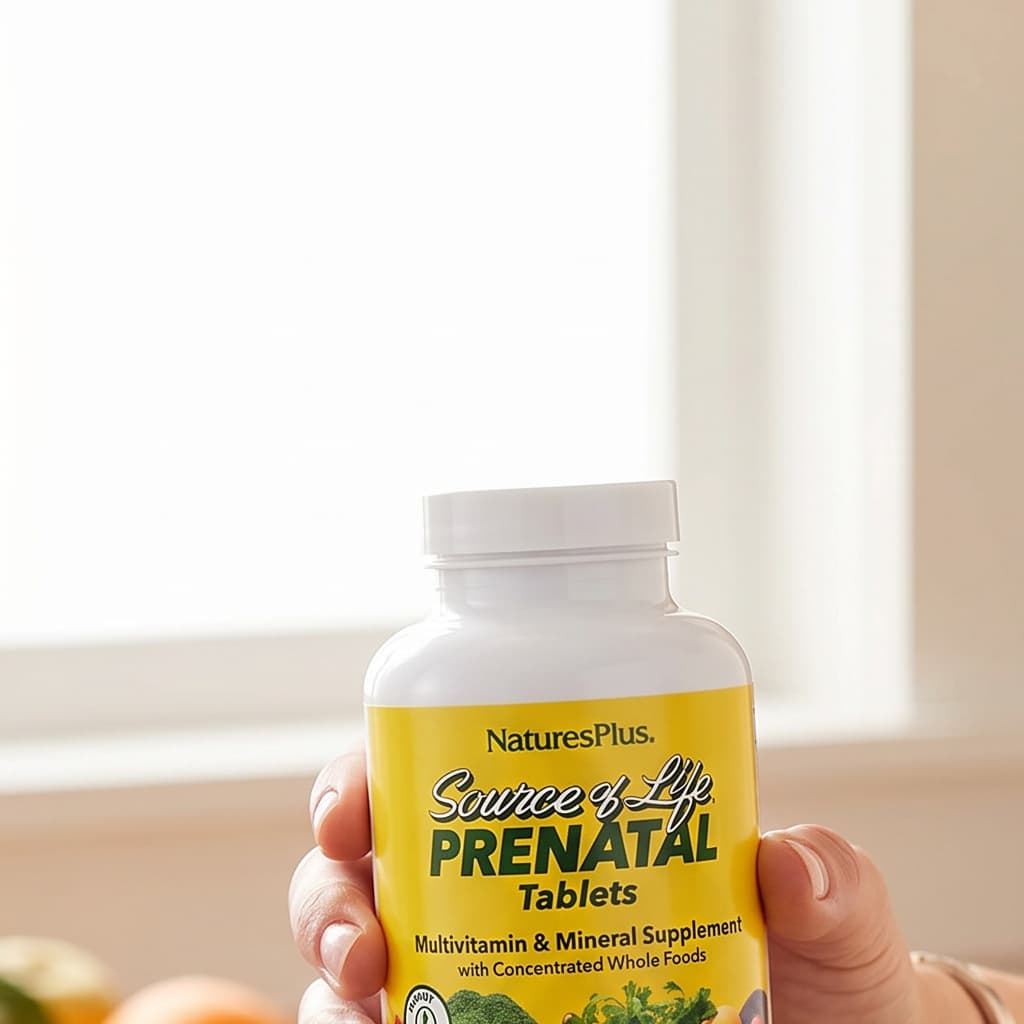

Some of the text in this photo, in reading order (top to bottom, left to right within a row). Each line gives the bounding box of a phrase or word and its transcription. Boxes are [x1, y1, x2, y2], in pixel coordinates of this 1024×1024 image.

[431, 768, 585, 824] Source
[588, 774, 629, 822] of
[430, 813, 717, 877] PRENATAL
[518, 881, 638, 911] Tablets
[415, 916, 743, 954] Multivitamin & Mineral Supplement
[458, 947, 707, 977] with Concentrated Whole Foods
